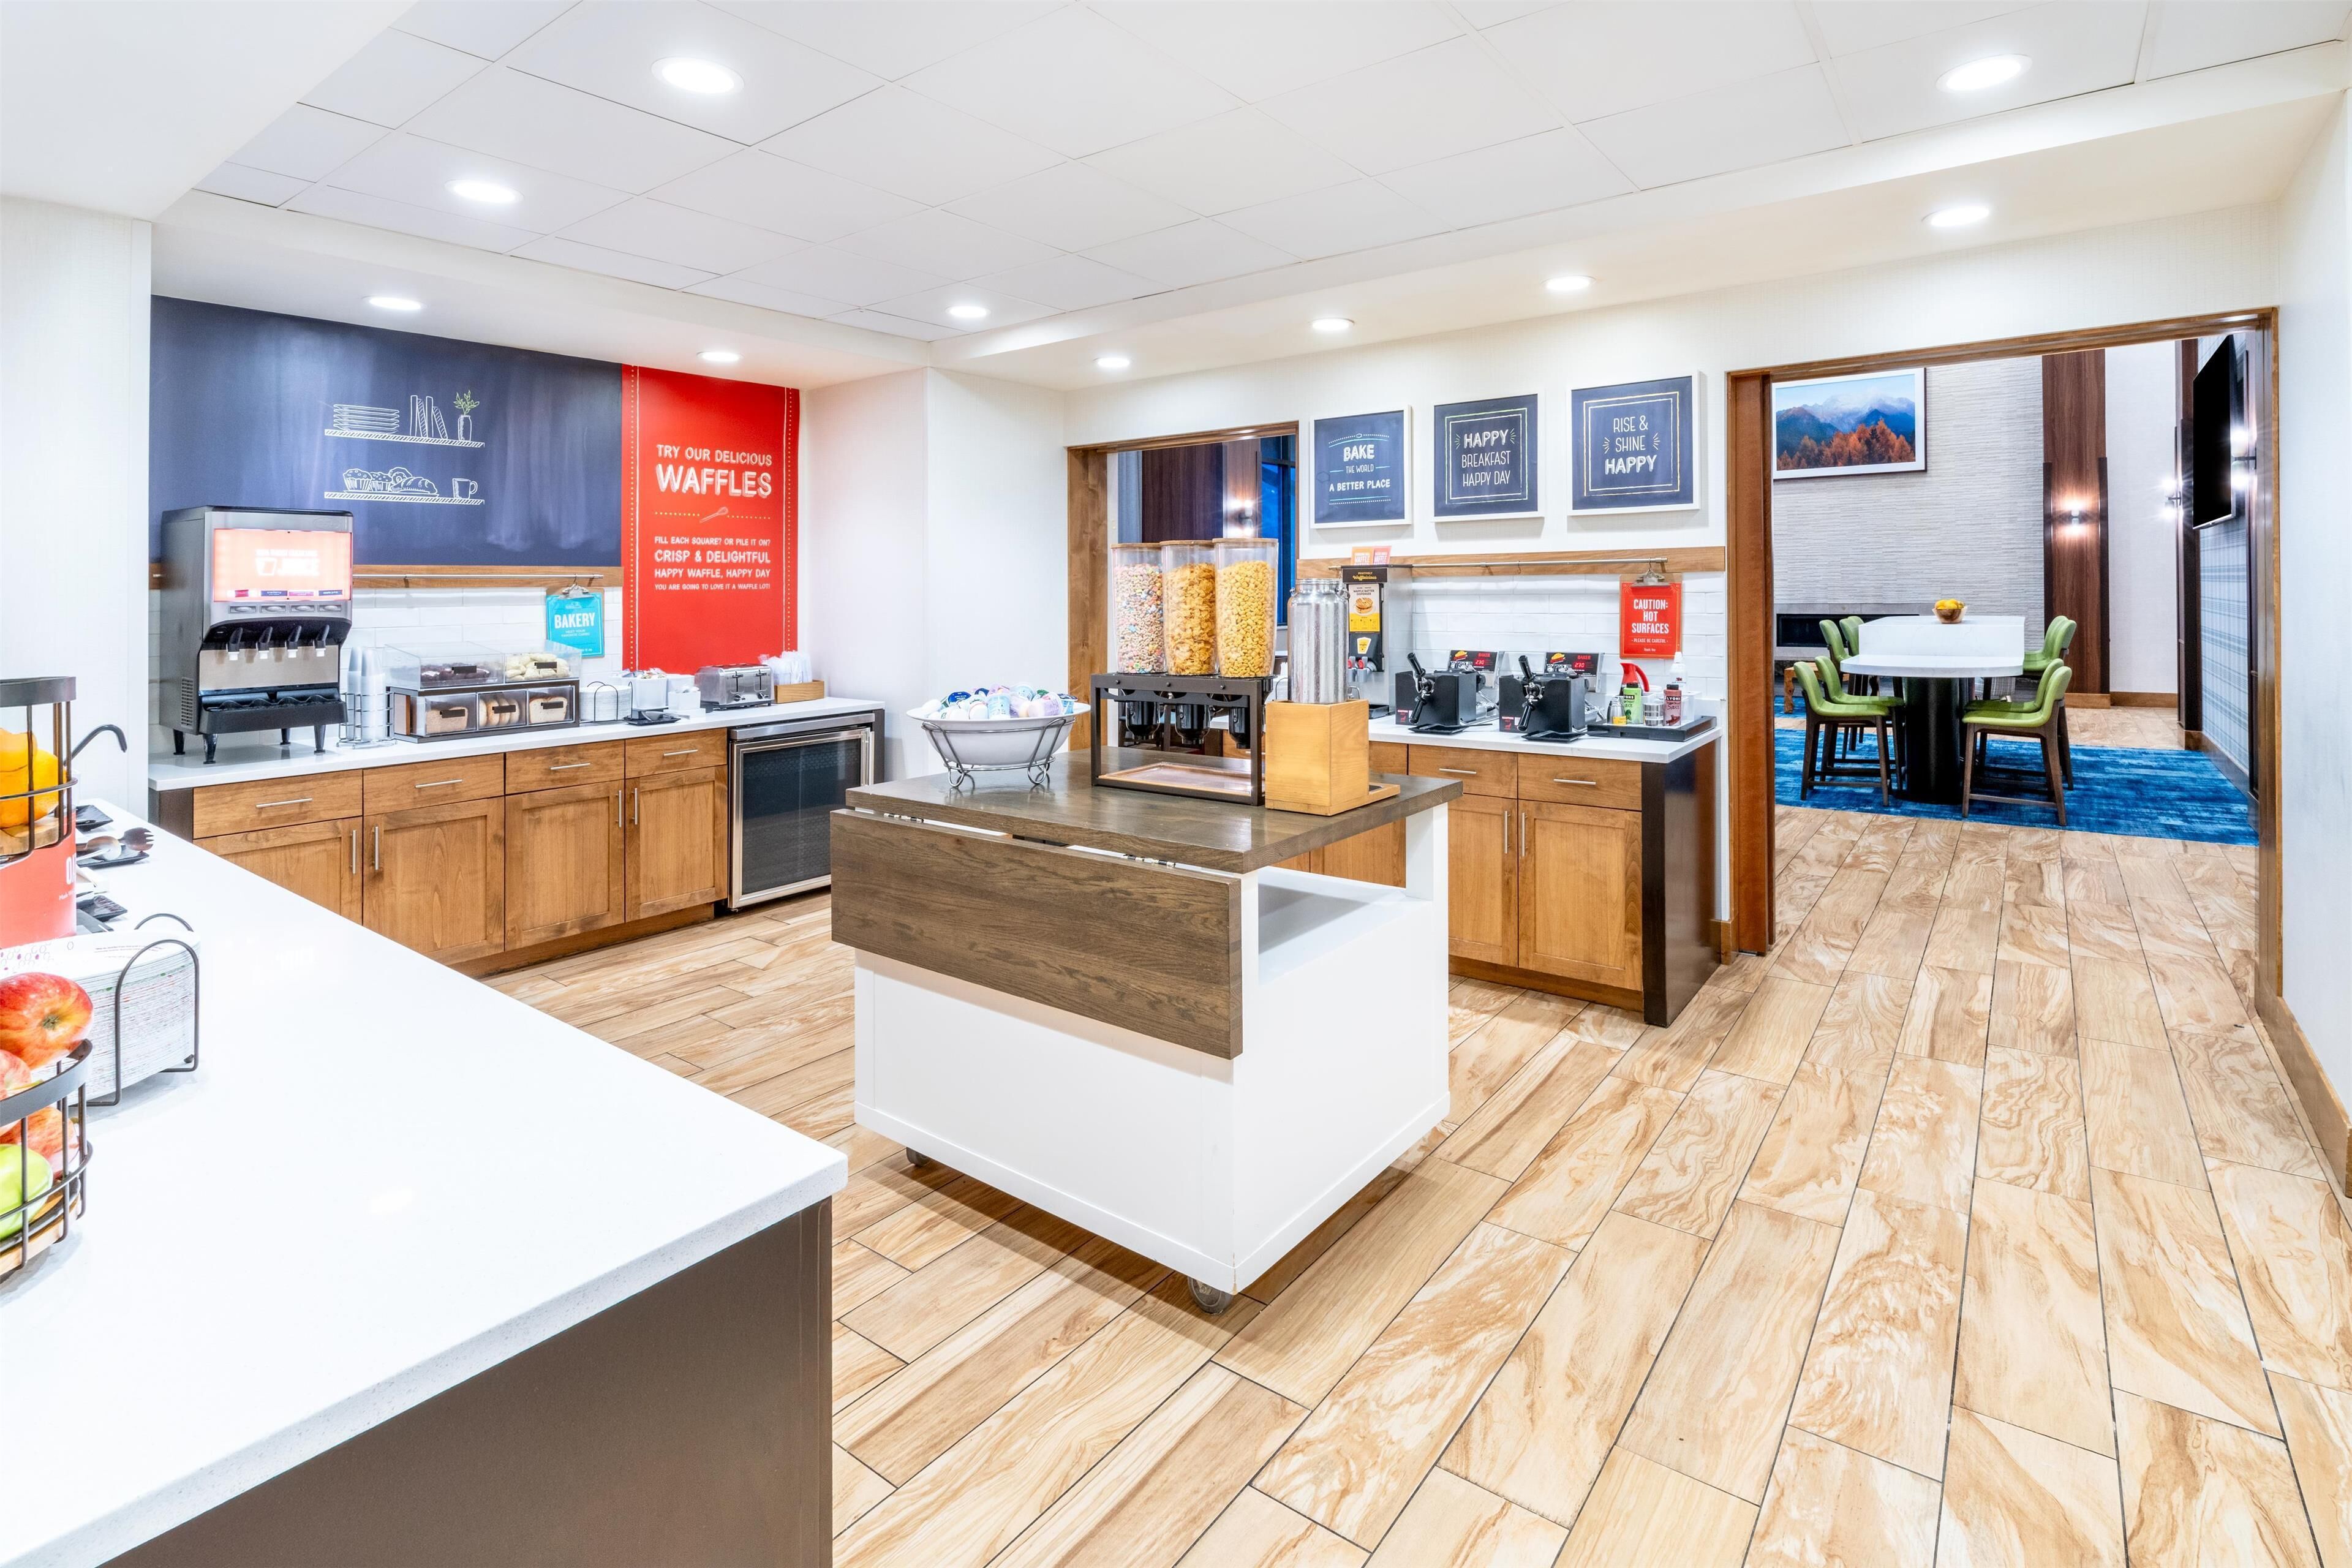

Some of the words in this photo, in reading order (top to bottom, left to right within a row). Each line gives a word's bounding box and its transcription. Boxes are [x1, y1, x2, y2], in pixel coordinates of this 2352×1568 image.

[1613, 417, 1635, 433] RISE
[1639, 415, 1648, 431] &
[1464, 429, 1509, 448] HAPPY
[1615, 435, 1646, 452] SHINE
[657, 444, 680, 459] TRY
[685, 447, 710, 461] OUR
[715, 450, 772, 467] DELICIOUS
[1343, 444, 1374, 462] BAKE
[1461, 450, 1511, 468] BREAKFAST
[1356, 464, 1374, 473] WORLD
[1605, 454, 1657, 475] HAPPY
[655, 463, 772, 499] WAFFLES
[1329, 483, 1335, 492] A
[1337, 481, 1365, 491] BETTER
[1366, 478, 1390, 489] PLACE
[1463, 471, 1491, 487] HAPPY
[1494, 470, 1510, 484] DAY
[654, 549, 690, 563] CRISP
[695, 550, 702, 562] &
[706, 551, 771, 564] DELIGHTFUL
[654, 568, 684, 578] HAPPY
[687, 568, 723, 579] WAFFLE,
[726, 569, 753, 578] HAPPY
[755, 569, 771, 578] DAY
[1634, 599, 1668, 610] CAUTION:
[554, 612, 595, 629] BAKERY
[1643, 611, 1658, 622] HOT
[1632, 623, 1669, 634] SURFACES
